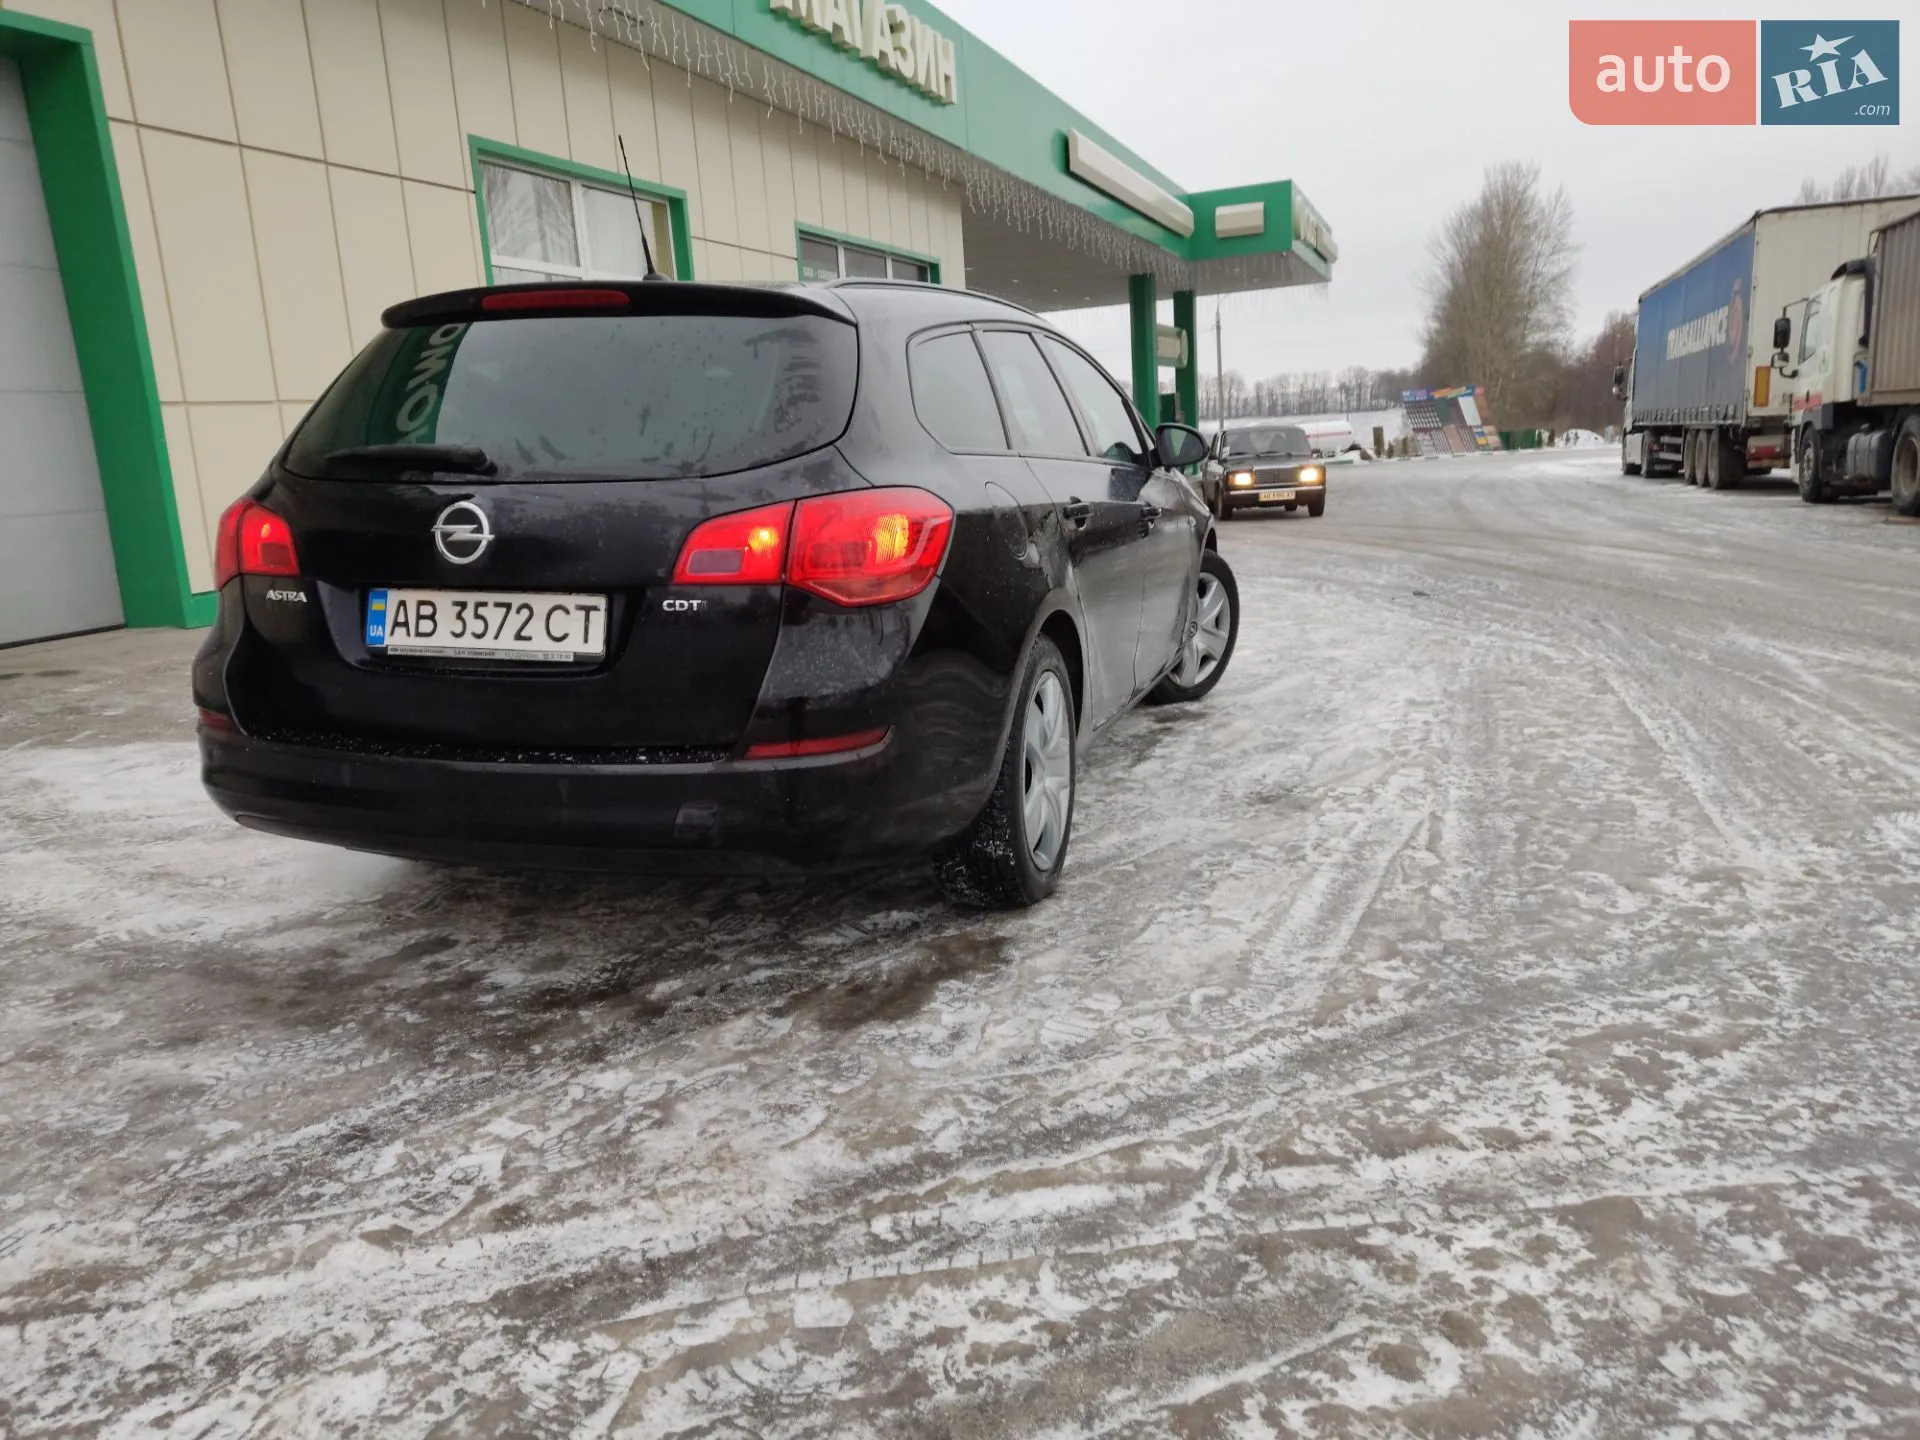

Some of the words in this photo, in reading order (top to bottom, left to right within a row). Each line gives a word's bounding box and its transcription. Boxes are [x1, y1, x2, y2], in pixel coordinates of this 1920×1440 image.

[769, 0, 957, 104] АГАЗИН
[265, 589, 307, 603] ASTRA
[369, 624, 384, 637] UA
[389, 599, 438, 637] AB
[449, 600, 535, 641] 3572
[544, 604, 601, 644] CT
